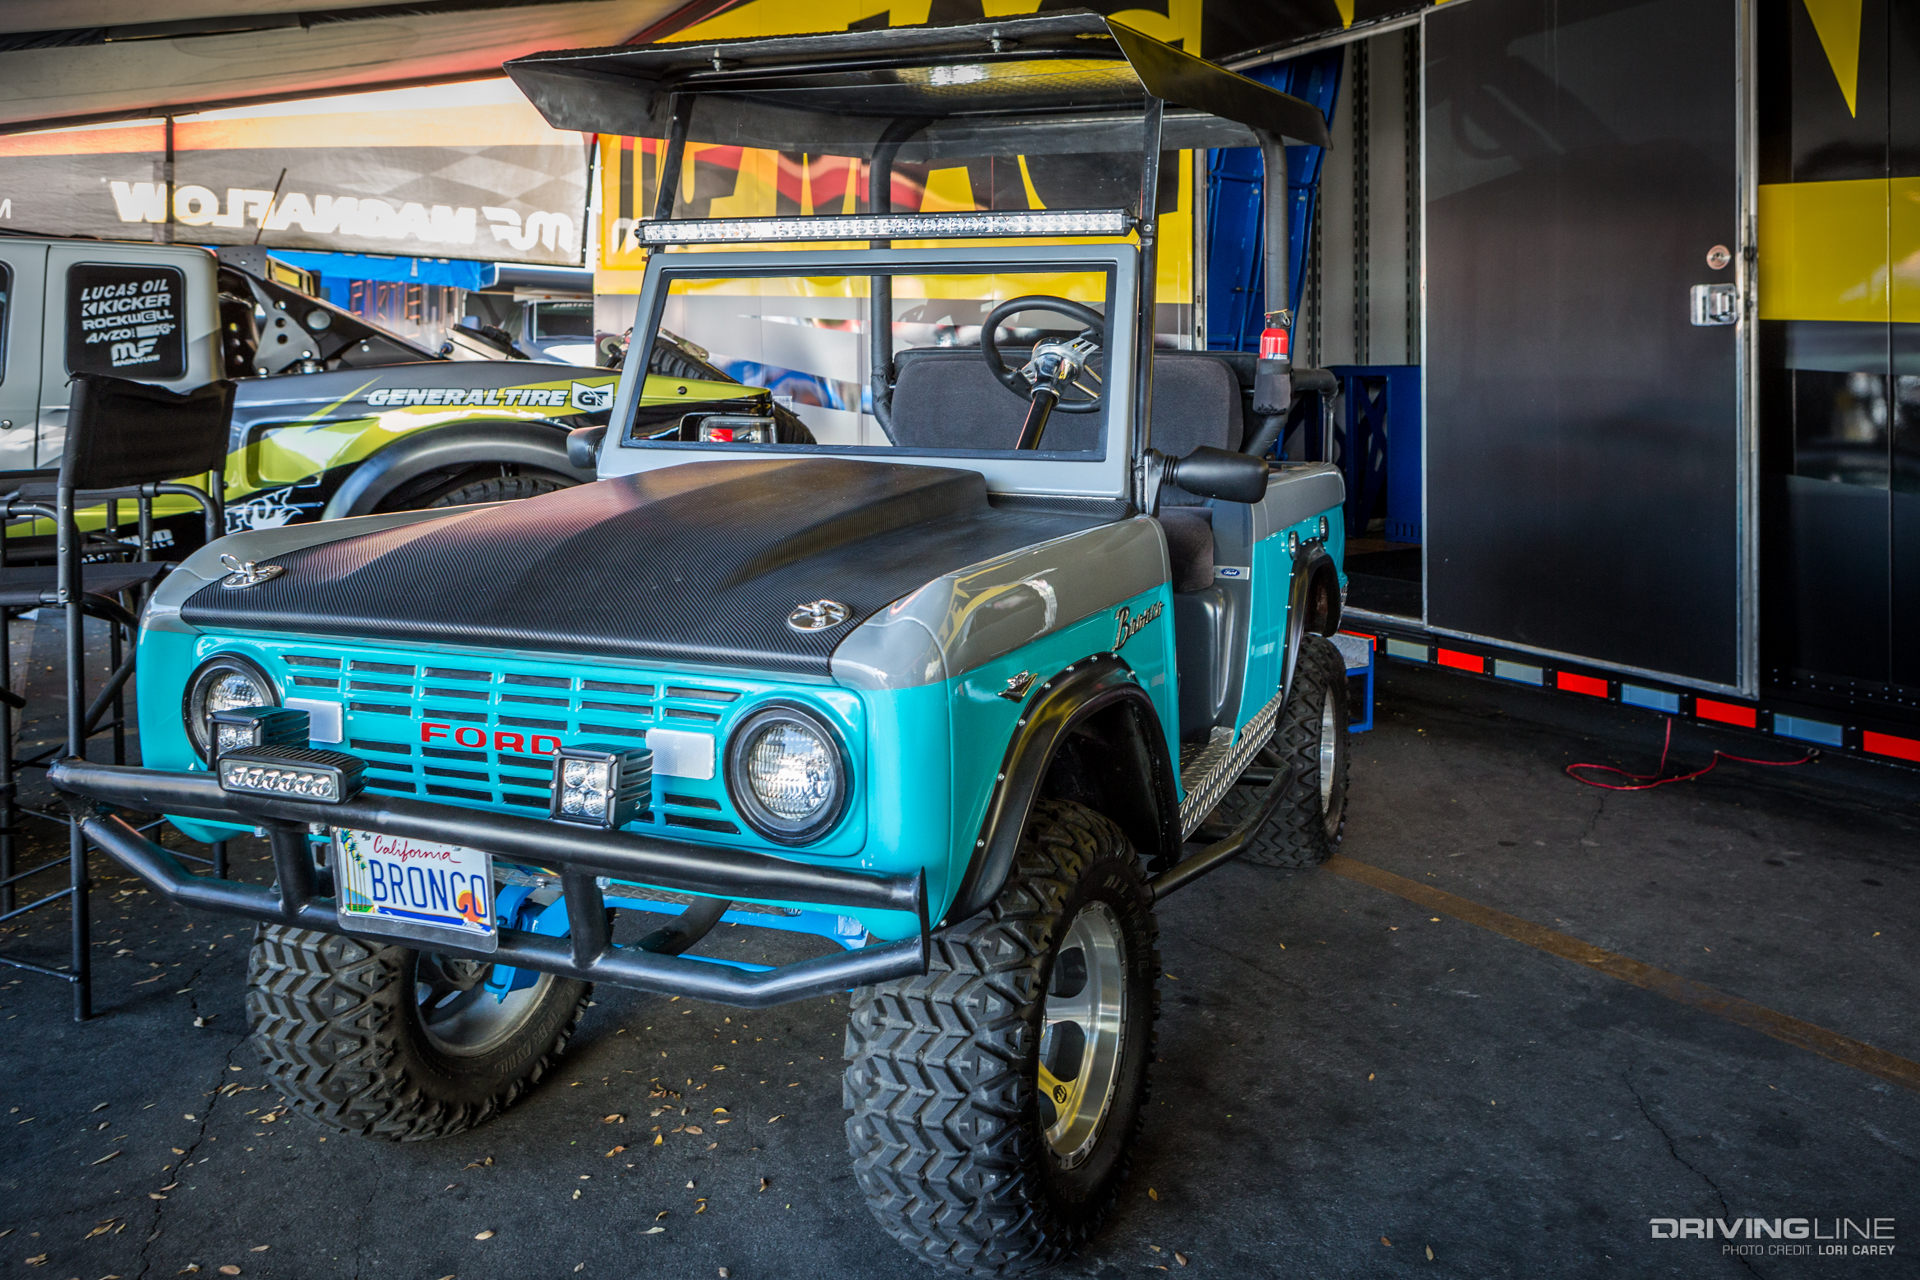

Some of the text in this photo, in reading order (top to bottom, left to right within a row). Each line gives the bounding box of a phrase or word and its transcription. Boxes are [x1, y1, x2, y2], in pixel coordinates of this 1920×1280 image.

[81, 279, 169, 301] LUCAS OIL
[97, 293, 172, 315] KICKER
[81, 309, 175, 331] ROCKWELL
[85, 328, 132, 345] ANZO
[225, 486, 298, 535] FOX
[1110, 601, 1165, 652] Bronco
[421, 722, 562, 756] FORD
[373, 835, 461, 863] California
[369, 860, 487, 918] BRONCO
